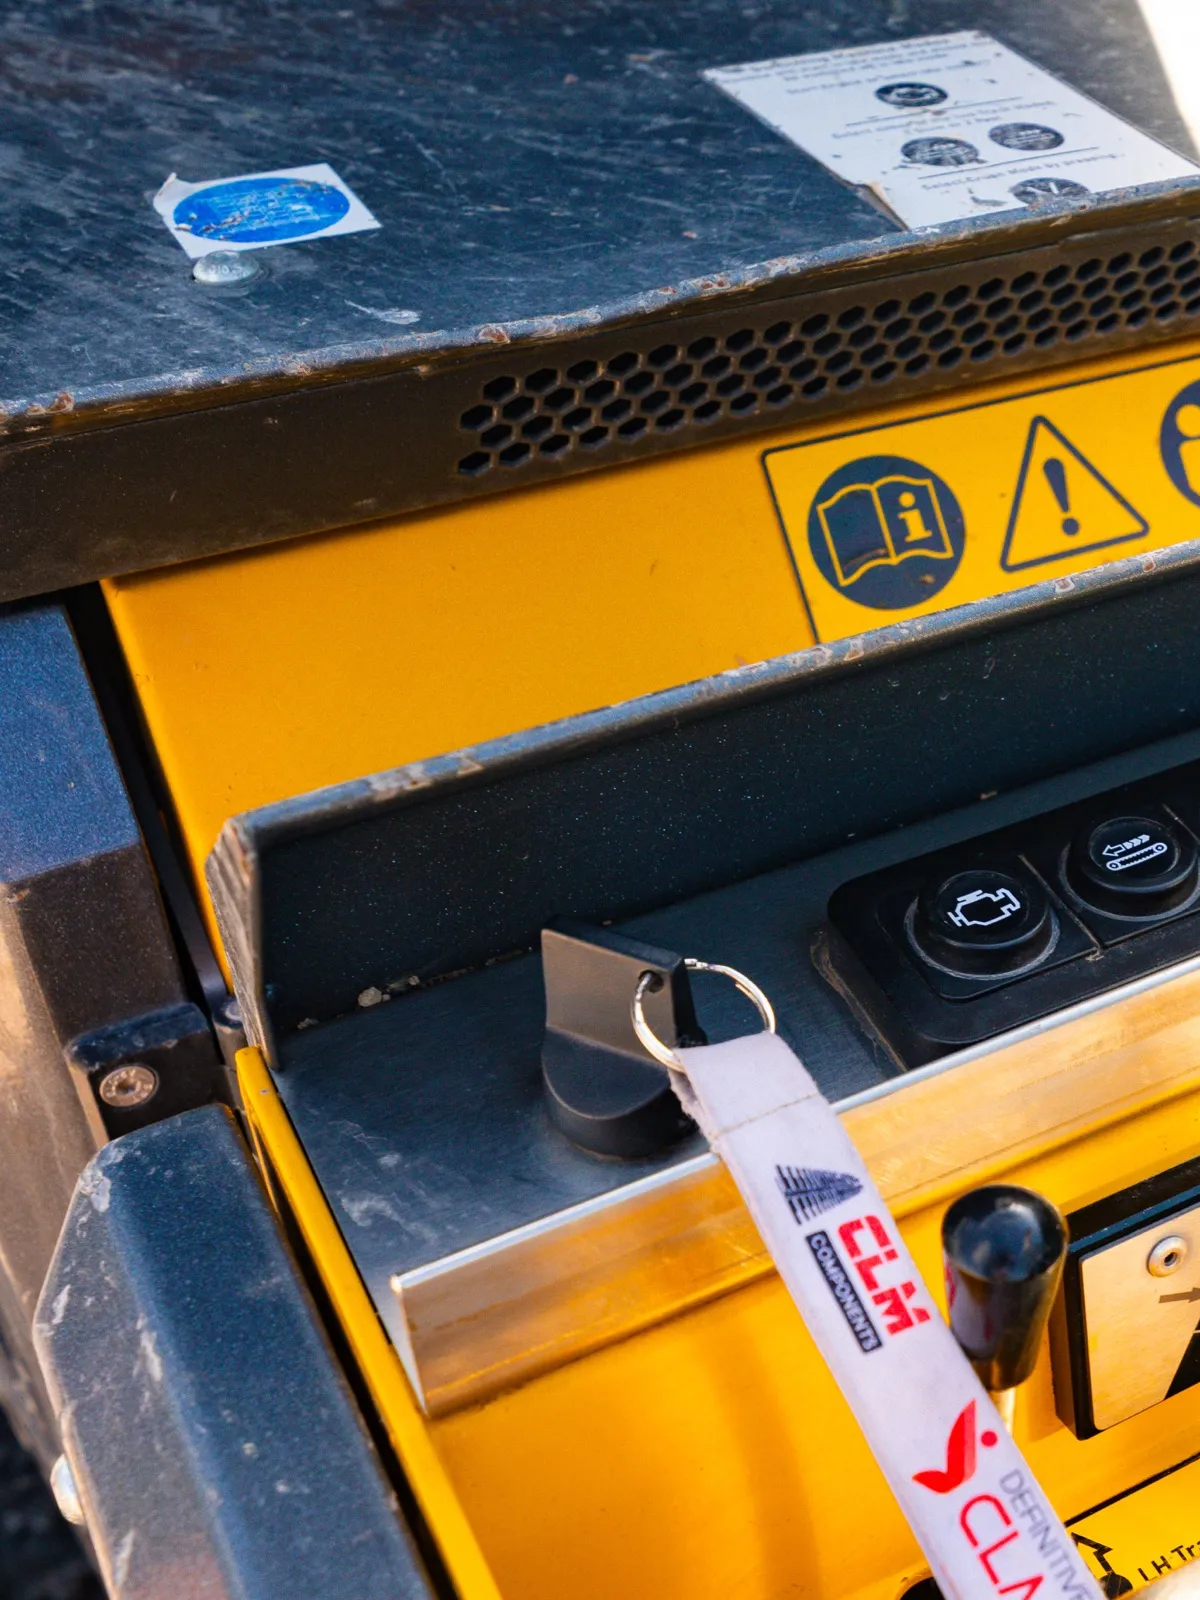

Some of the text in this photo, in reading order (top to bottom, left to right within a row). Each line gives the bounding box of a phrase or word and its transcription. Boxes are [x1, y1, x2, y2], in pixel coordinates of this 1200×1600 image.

[809, 1232, 880, 1351] COMPONENTS
[837, 1214, 931, 1336] CLM
[1137, 1555, 1173, 1582] LH
